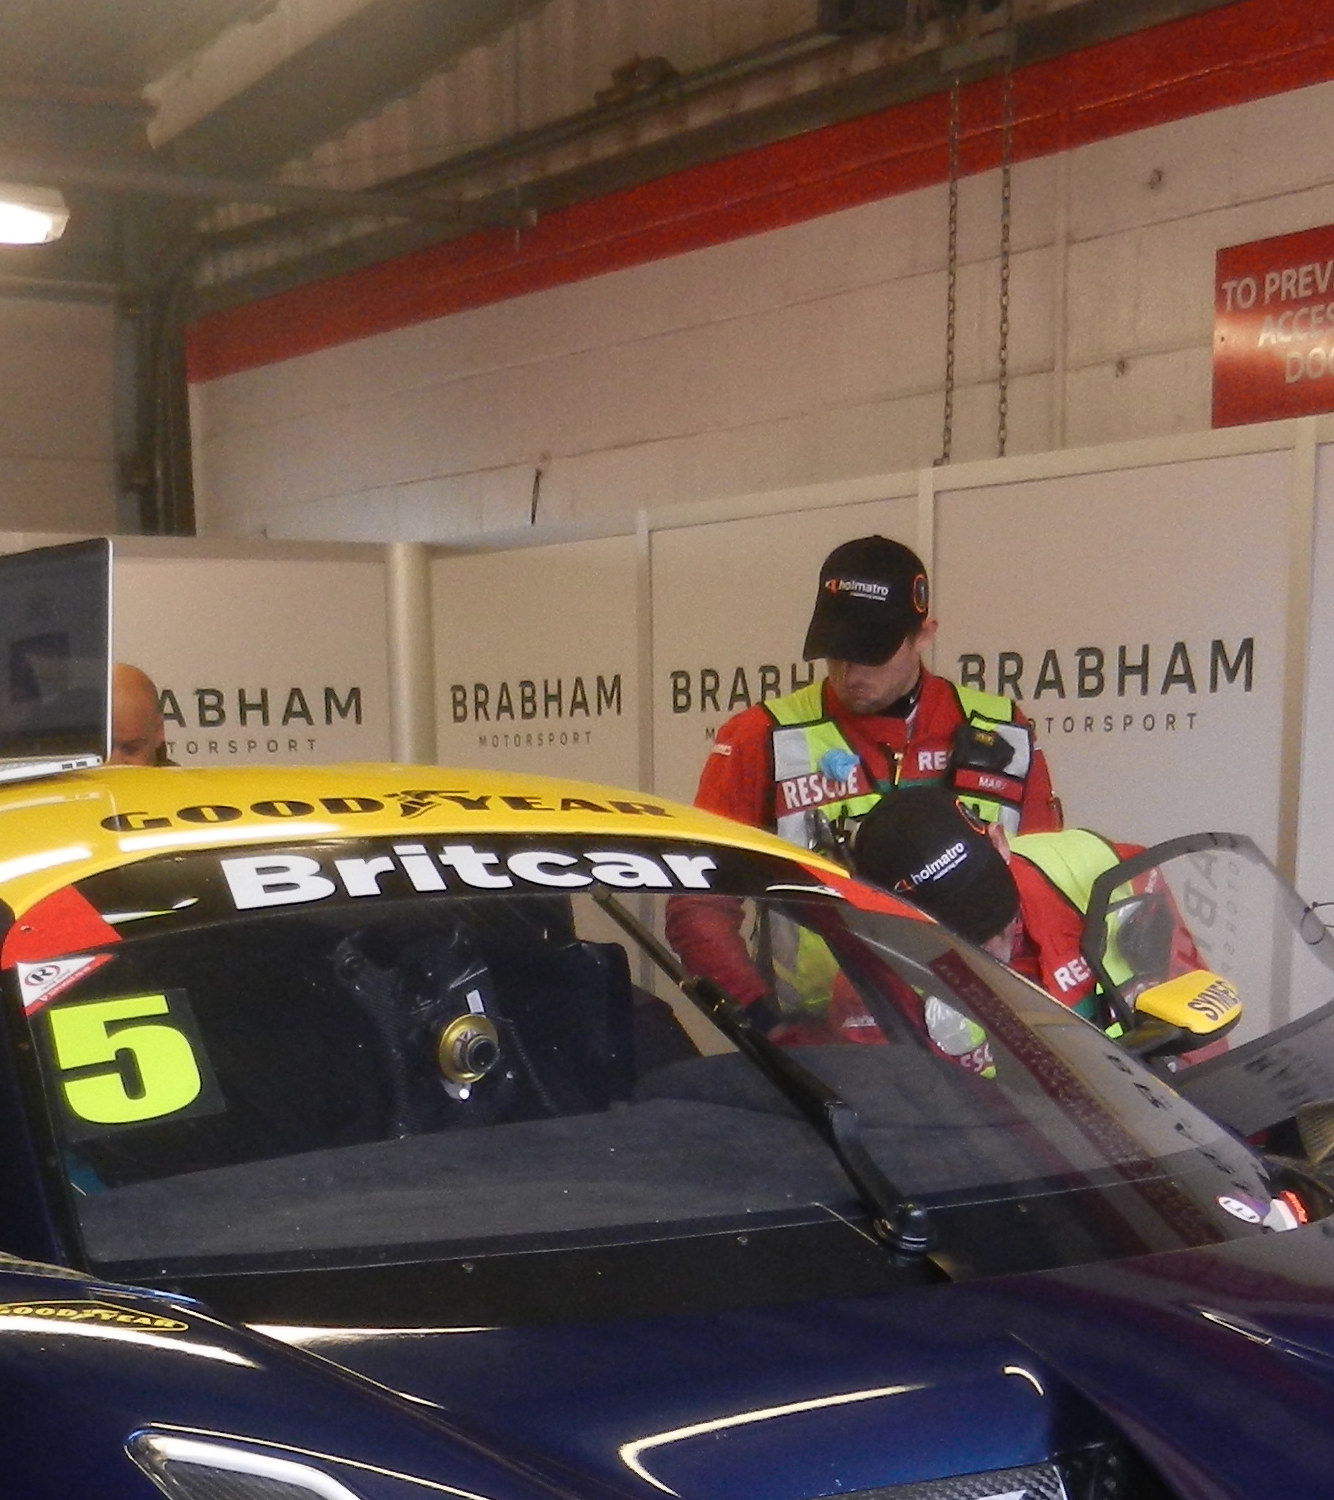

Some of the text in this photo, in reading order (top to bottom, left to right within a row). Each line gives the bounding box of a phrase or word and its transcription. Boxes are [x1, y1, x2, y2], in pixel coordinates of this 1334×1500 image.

[1221, 278, 1257, 311] TO
[839, 579, 889, 597] holmatro
[958, 637, 1255, 701] BRABHAM
[450, 674, 622, 723] BRABHAM
[479, 731, 592, 749] MOTORSPORT
[220, 844, 719, 910] Britcar
[911, 841, 966, 885] holmatro
[49, 995, 203, 1125] 5
